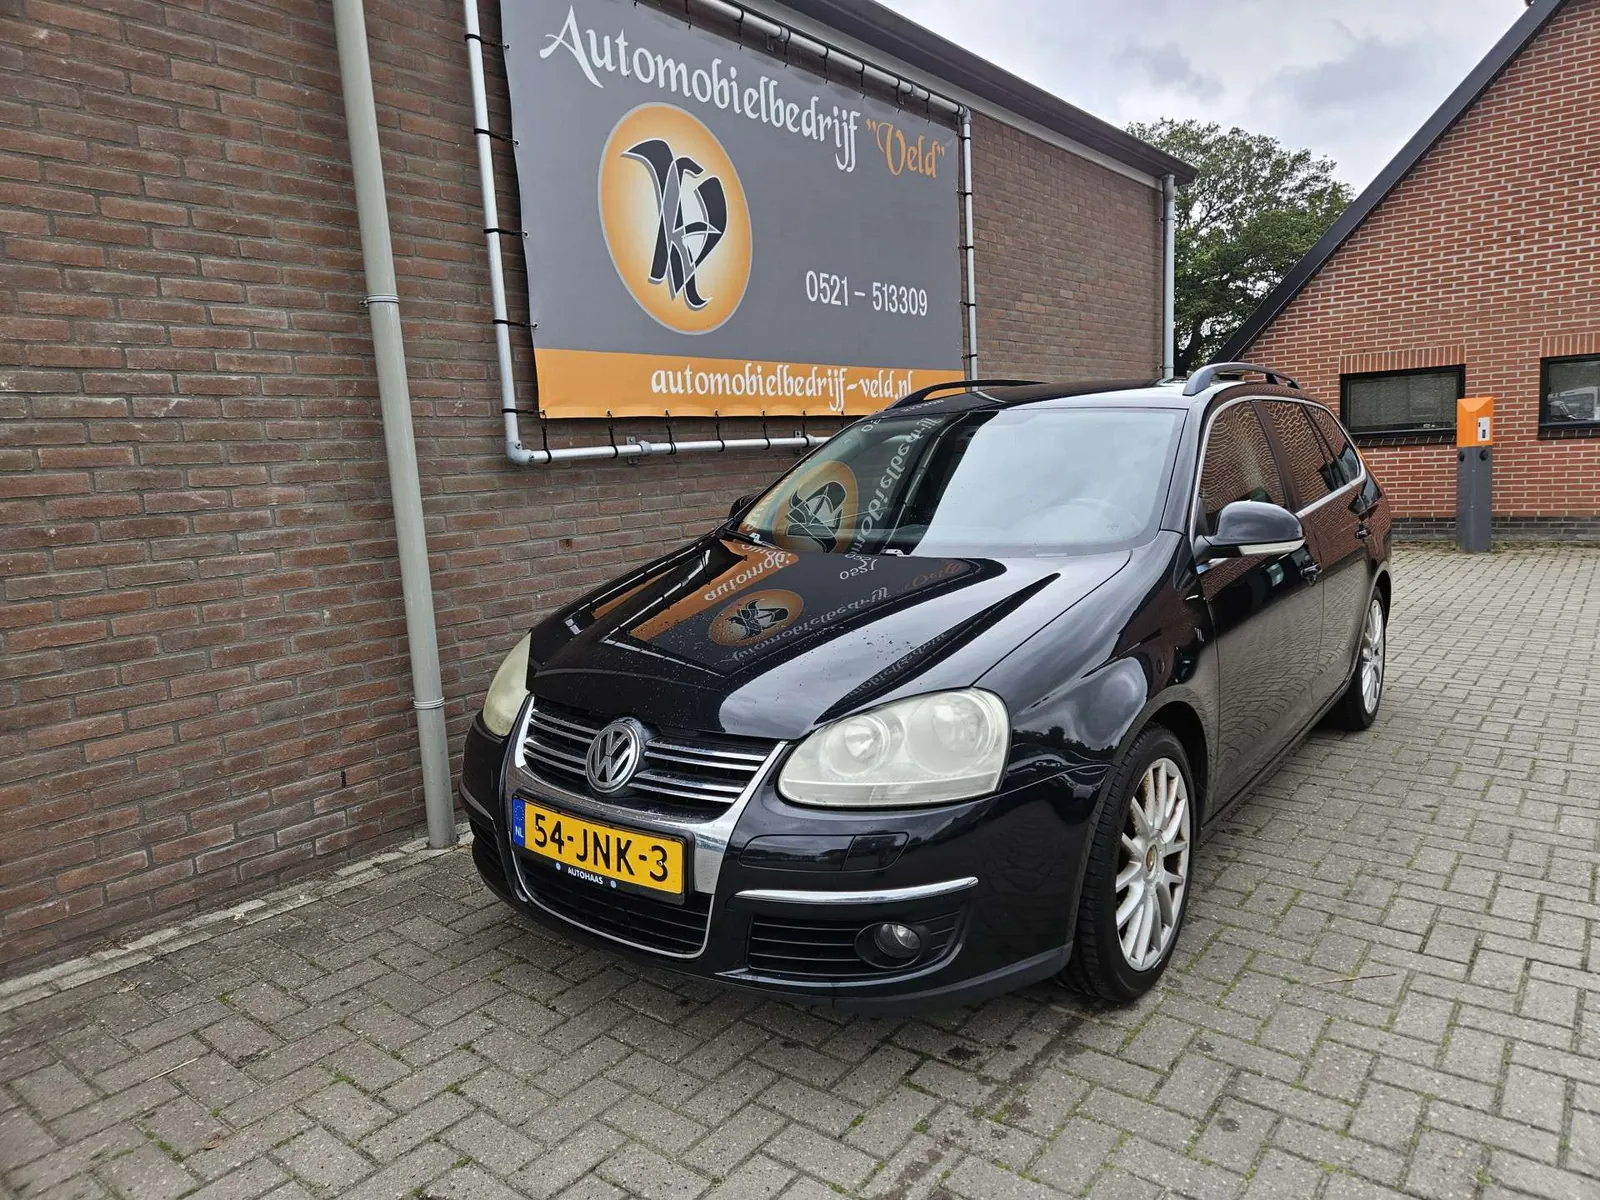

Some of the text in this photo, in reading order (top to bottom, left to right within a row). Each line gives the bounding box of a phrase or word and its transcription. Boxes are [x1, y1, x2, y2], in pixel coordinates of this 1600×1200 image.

[539, 5, 861, 172] Automobielbedrijf
[805, 270, 848, 306] 0521
[872, 282, 928, 316] 513309
[651, 363, 913, 412] automobielbedrijf-veld.nl
[515, 825, 524, 838] NL
[534, 813, 669, 882] 54-JNK-3
[567, 866, 604, 885] AUTOHAAS
